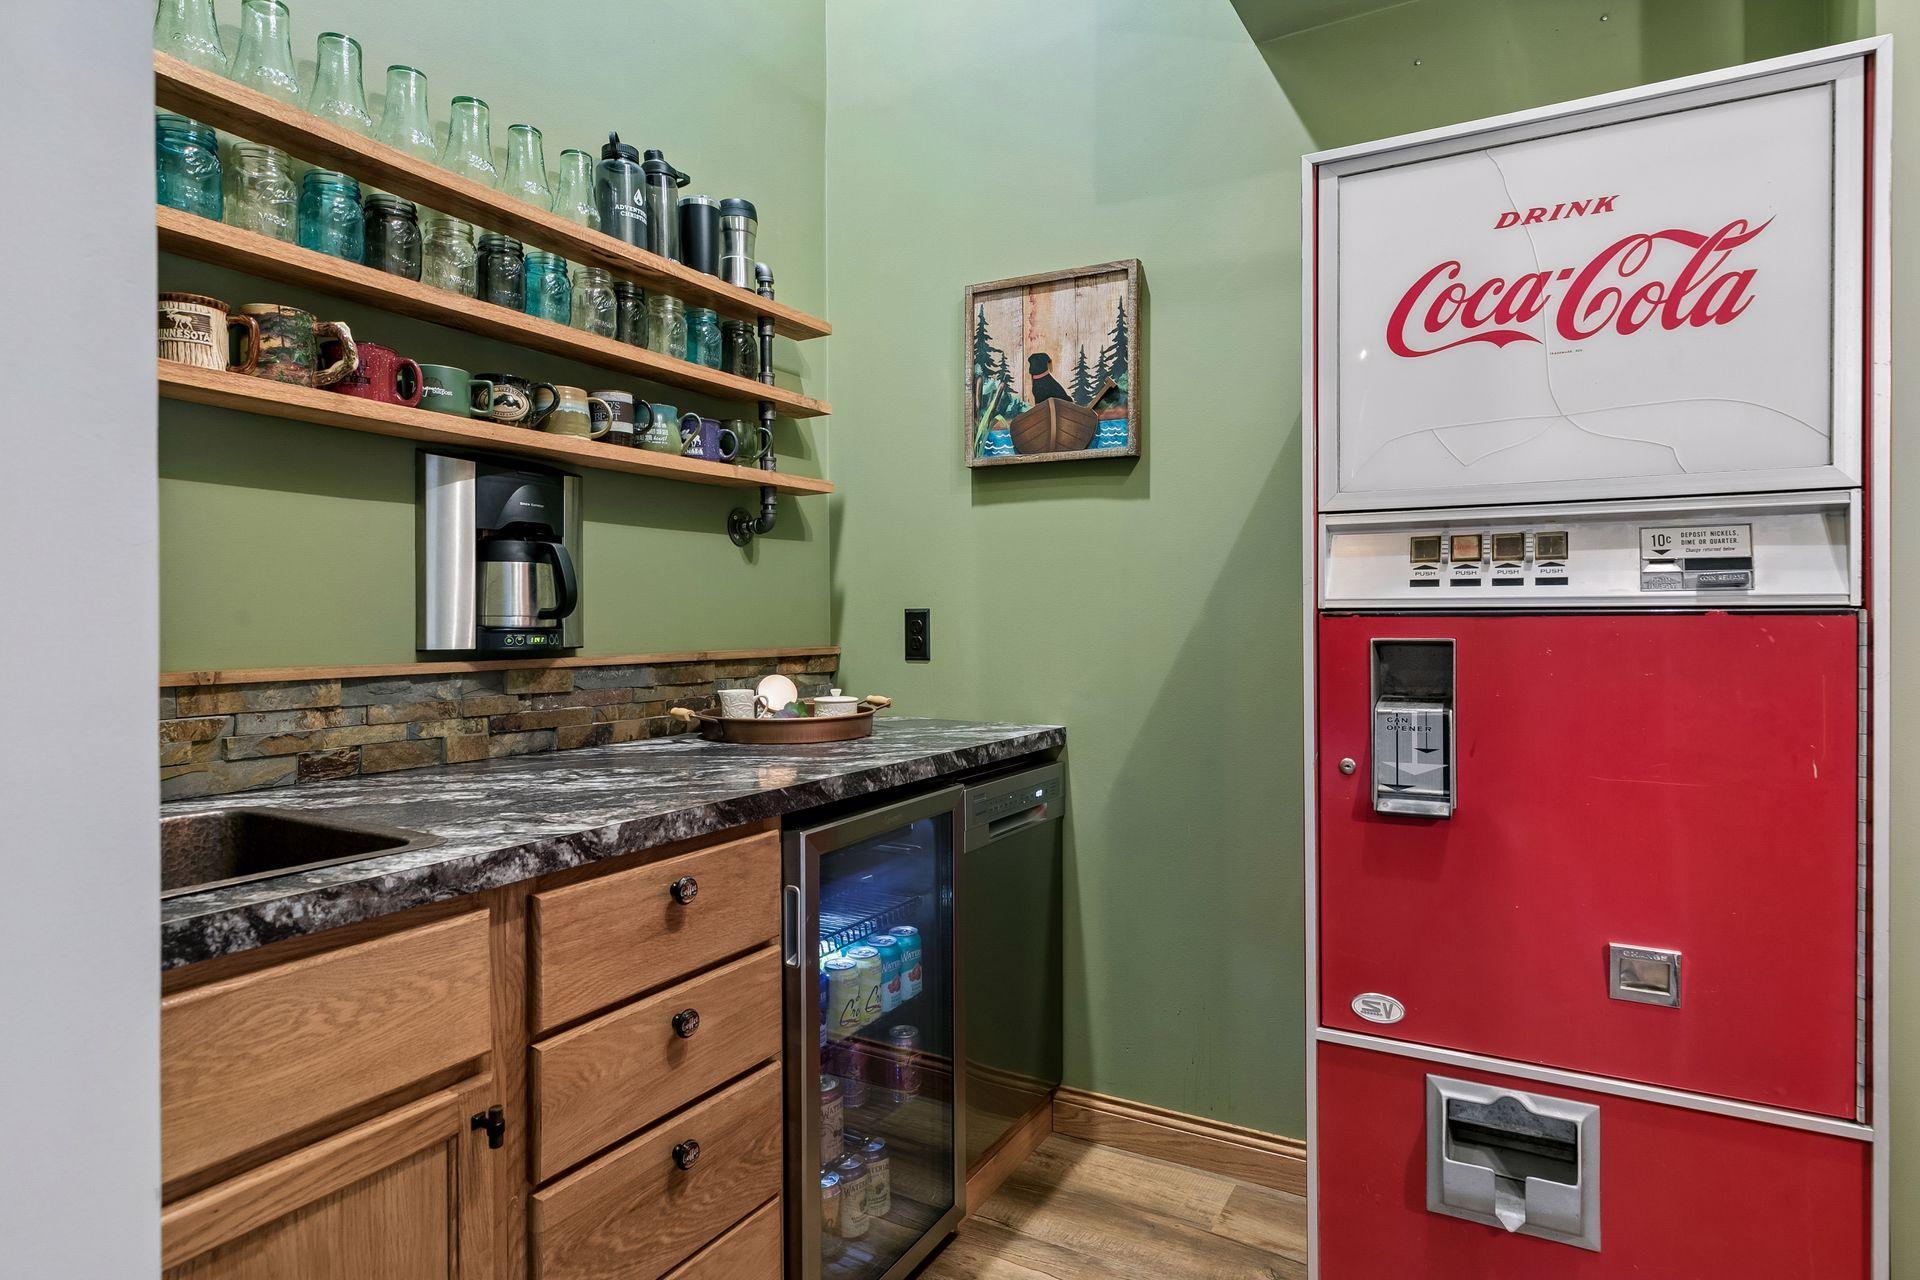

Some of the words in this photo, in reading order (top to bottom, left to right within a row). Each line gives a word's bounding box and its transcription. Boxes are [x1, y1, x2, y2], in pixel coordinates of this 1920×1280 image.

[1493, 194, 1621, 230] DRINK
[1386, 214, 1778, 358] Coca-Cola
[158, 327, 211, 343] INNESOTA
[594, 412, 621, 421] BET
[1386, 724, 1432, 732] OPENER
